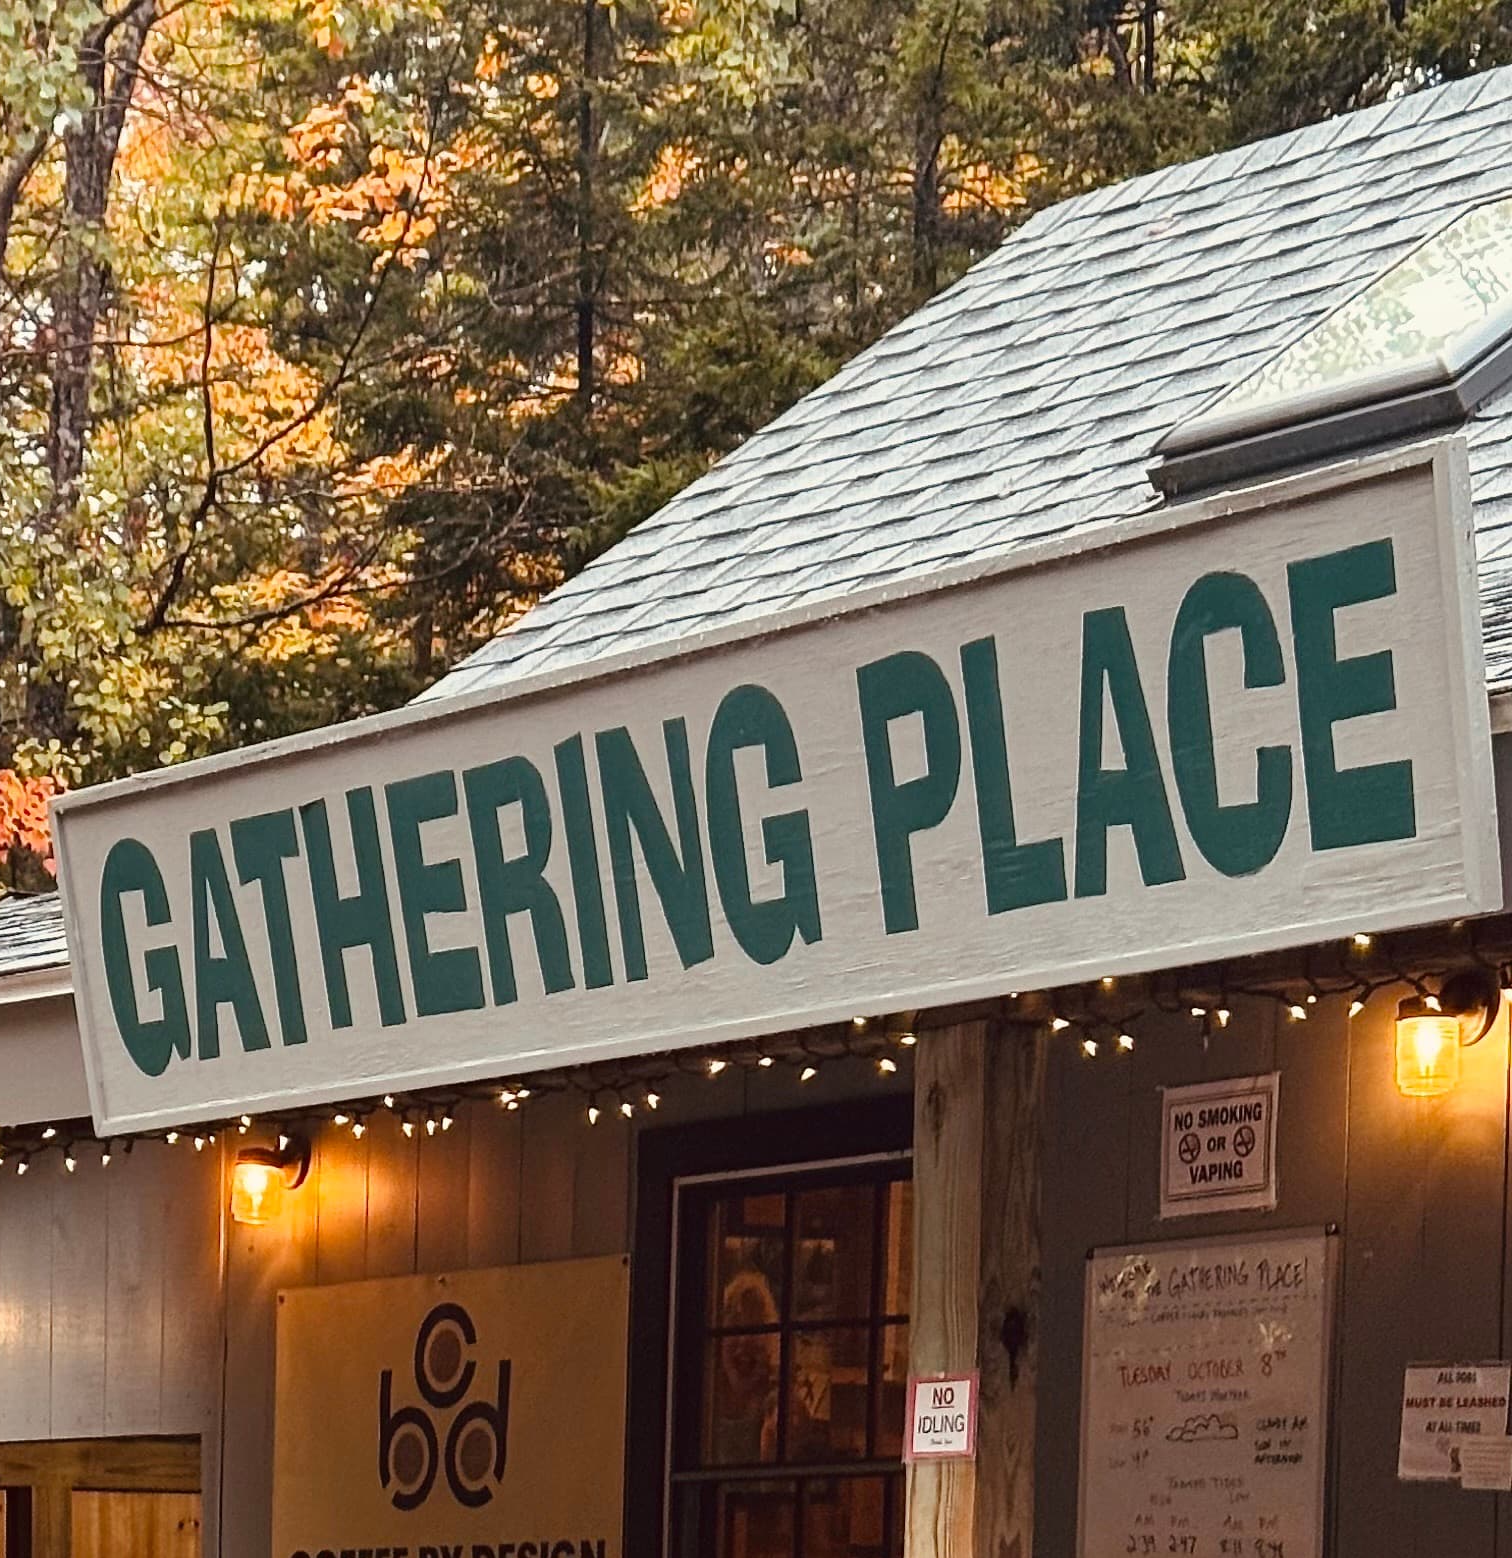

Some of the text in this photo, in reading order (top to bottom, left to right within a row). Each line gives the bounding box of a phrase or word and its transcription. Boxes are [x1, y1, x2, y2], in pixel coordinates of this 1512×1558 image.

[100, 537, 1417, 1076] GATHERING PLACE
[1174, 1102, 1263, 1131] NO SMOKING
[1207, 1136, 1226, 1152] OR
[1189, 1160, 1243, 1184] VAPING
[1167, 1260, 1249, 1299] GATHERING
[1118, 1360, 1173, 1389] TUESDAY
[1187, 1359, 1245, 1381] OCTOBER
[932, 1387, 955, 1405] NO
[1405, 1396, 1507, 1409] MUST BE LEASHED
[917, 1414, 965, 1434] IDLING
